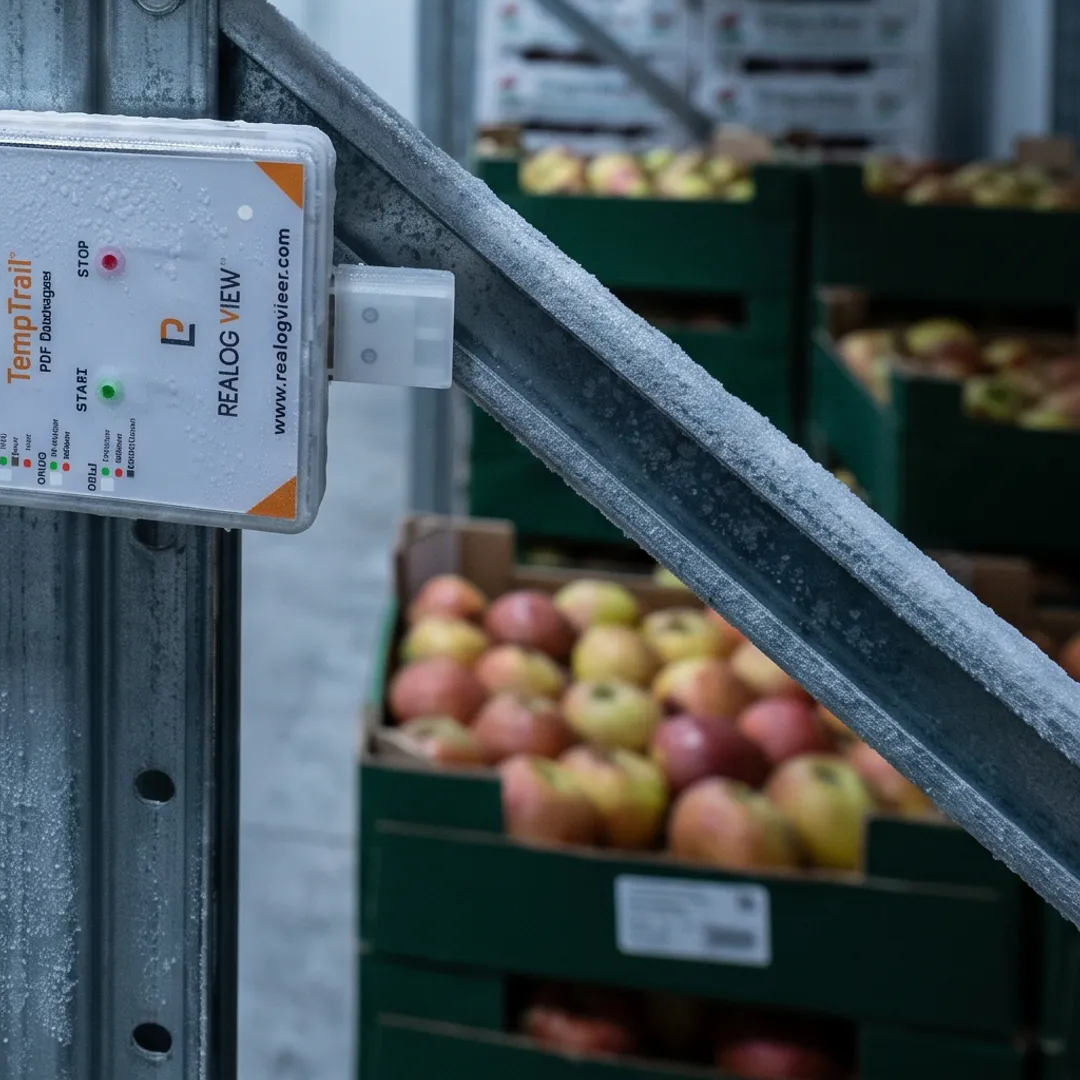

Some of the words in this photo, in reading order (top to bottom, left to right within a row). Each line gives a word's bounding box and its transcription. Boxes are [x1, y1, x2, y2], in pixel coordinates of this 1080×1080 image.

[77, 241, 90, 277] STOP
[8, 259, 38, 384] TempTrail
[220, 268, 241, 324] VIEW
[39, 346, 52, 372] PDF
[218, 331, 240, 417] REALOG
